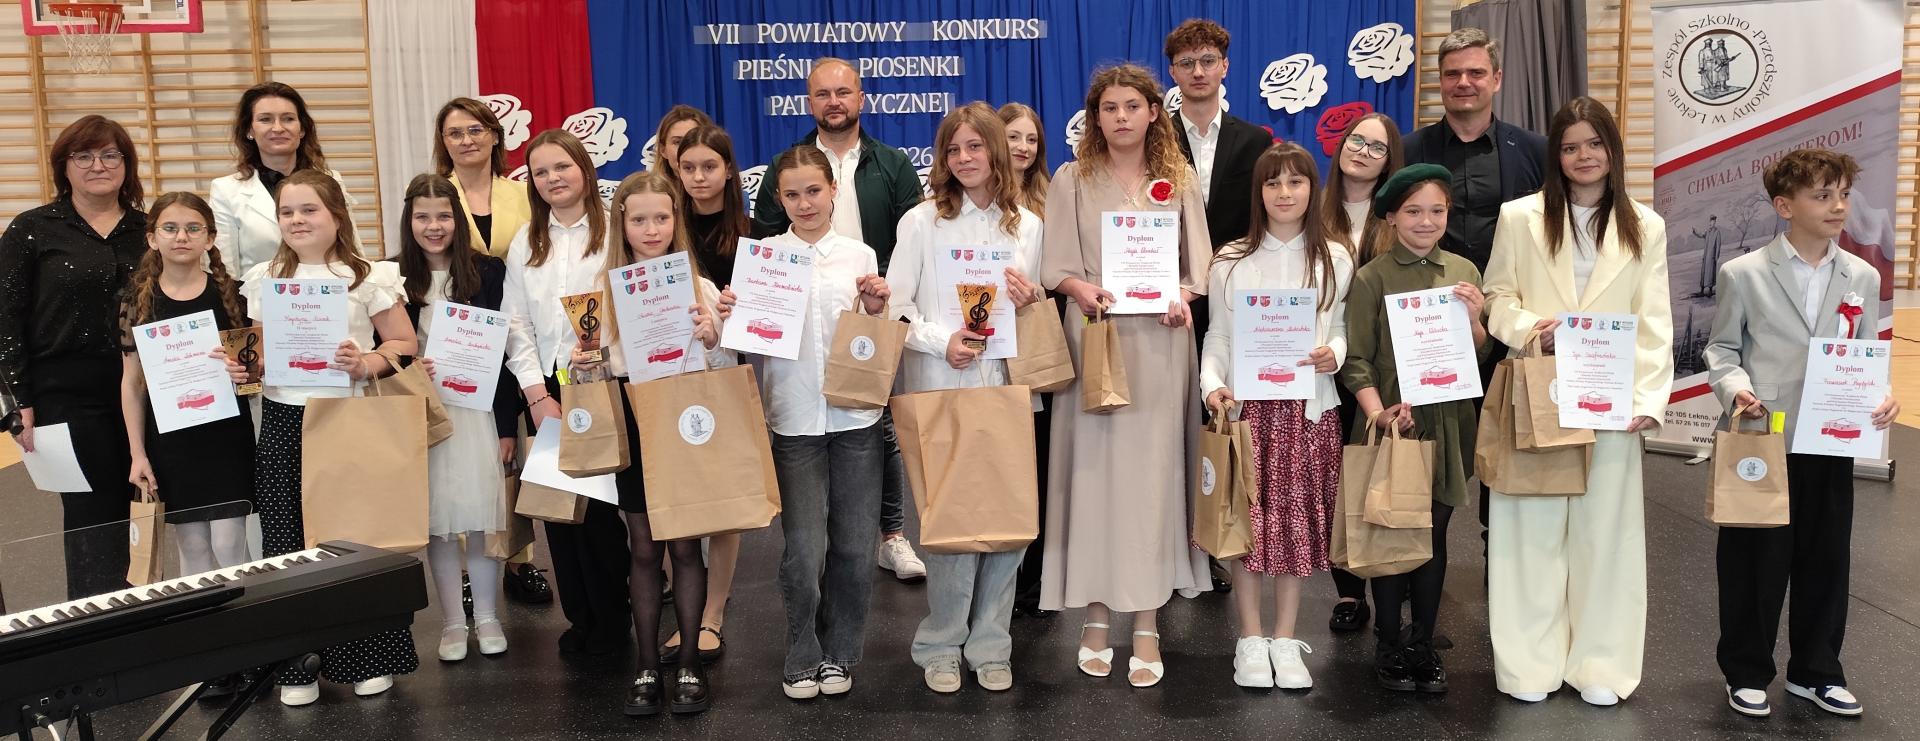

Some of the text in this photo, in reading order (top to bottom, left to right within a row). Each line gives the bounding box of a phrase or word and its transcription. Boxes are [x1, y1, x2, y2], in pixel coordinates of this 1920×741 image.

[1688, 13, 1750, 33] Szkolno
[707, 18, 1039, 45] VII POWIATOWY KONKURS
[737, 53, 960, 80] PIEŚNI PIOSENKI
[770, 91, 950, 118] PATYCZNEJ
[1127, 235, 1154, 244] Dyplom
[760, 266, 787, 277] Dyplom
[642, 294, 669, 305] Dyplom
[291, 302, 321, 310] Dyplom
[1261, 313, 1290, 322] Dyplom
[1415, 314, 1442, 323] Dyplom
[457, 327, 483, 337] Dyplom
[166, 340, 194, 351] Dyplom
[1581, 337, 1610, 346] Dyplom
[1835, 364, 1864, 373] Dyplom
